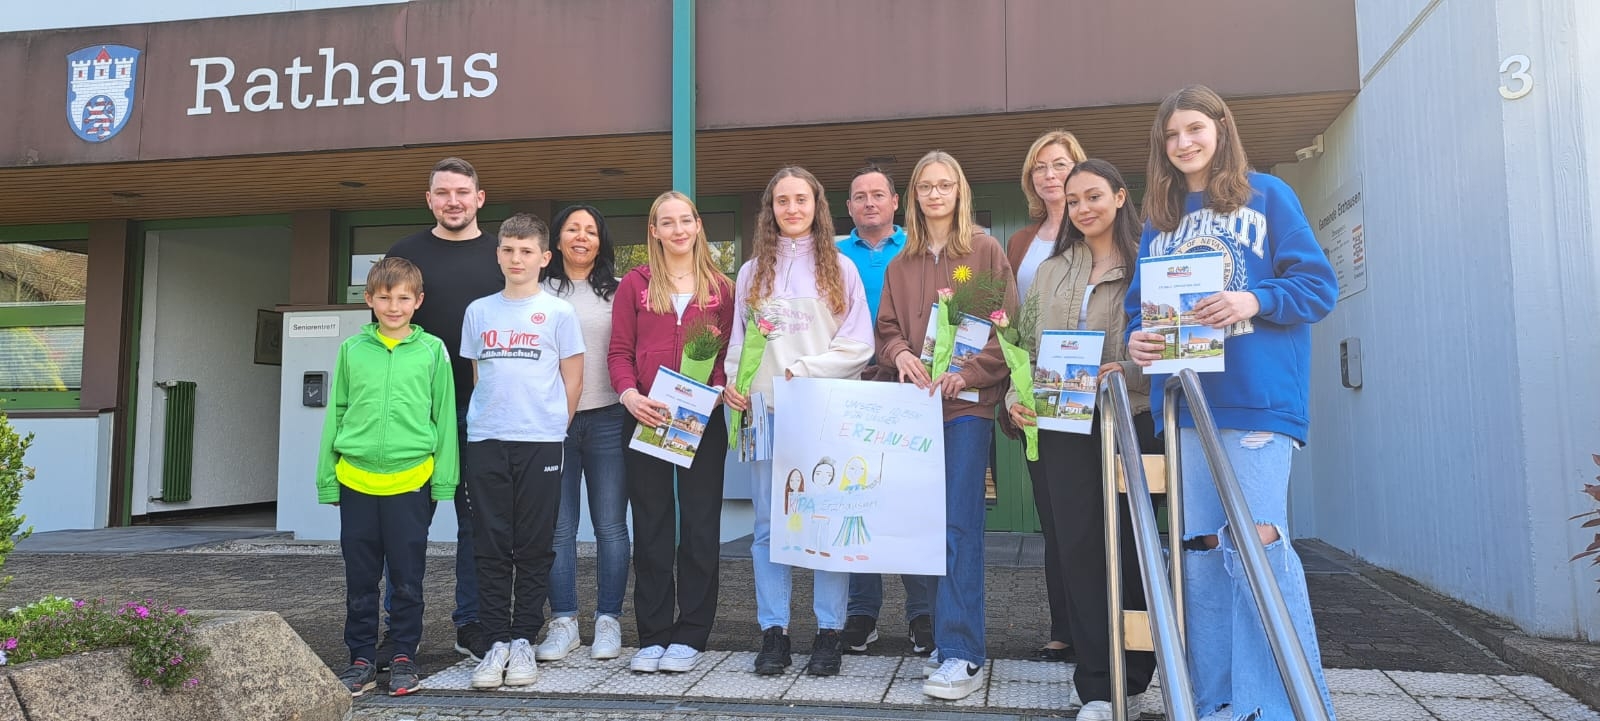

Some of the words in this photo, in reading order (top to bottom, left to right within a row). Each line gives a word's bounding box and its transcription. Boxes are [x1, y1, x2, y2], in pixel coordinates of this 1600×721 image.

[187, 47, 498, 115] Rathaus
[1499, 54, 1533, 100] 3
[1318, 208, 1337, 231] Gemeinde
[1337, 191, 1361, 217] Erzhausen
[293, 323, 336, 331] Seniorentreff
[481, 329, 497, 347] 10
[497, 329, 540, 351] Jahre
[480, 349, 539, 359] ußballschule
[845, 400, 882, 413] UNSERE
[839, 422, 933, 453] ERZHAUSEN
